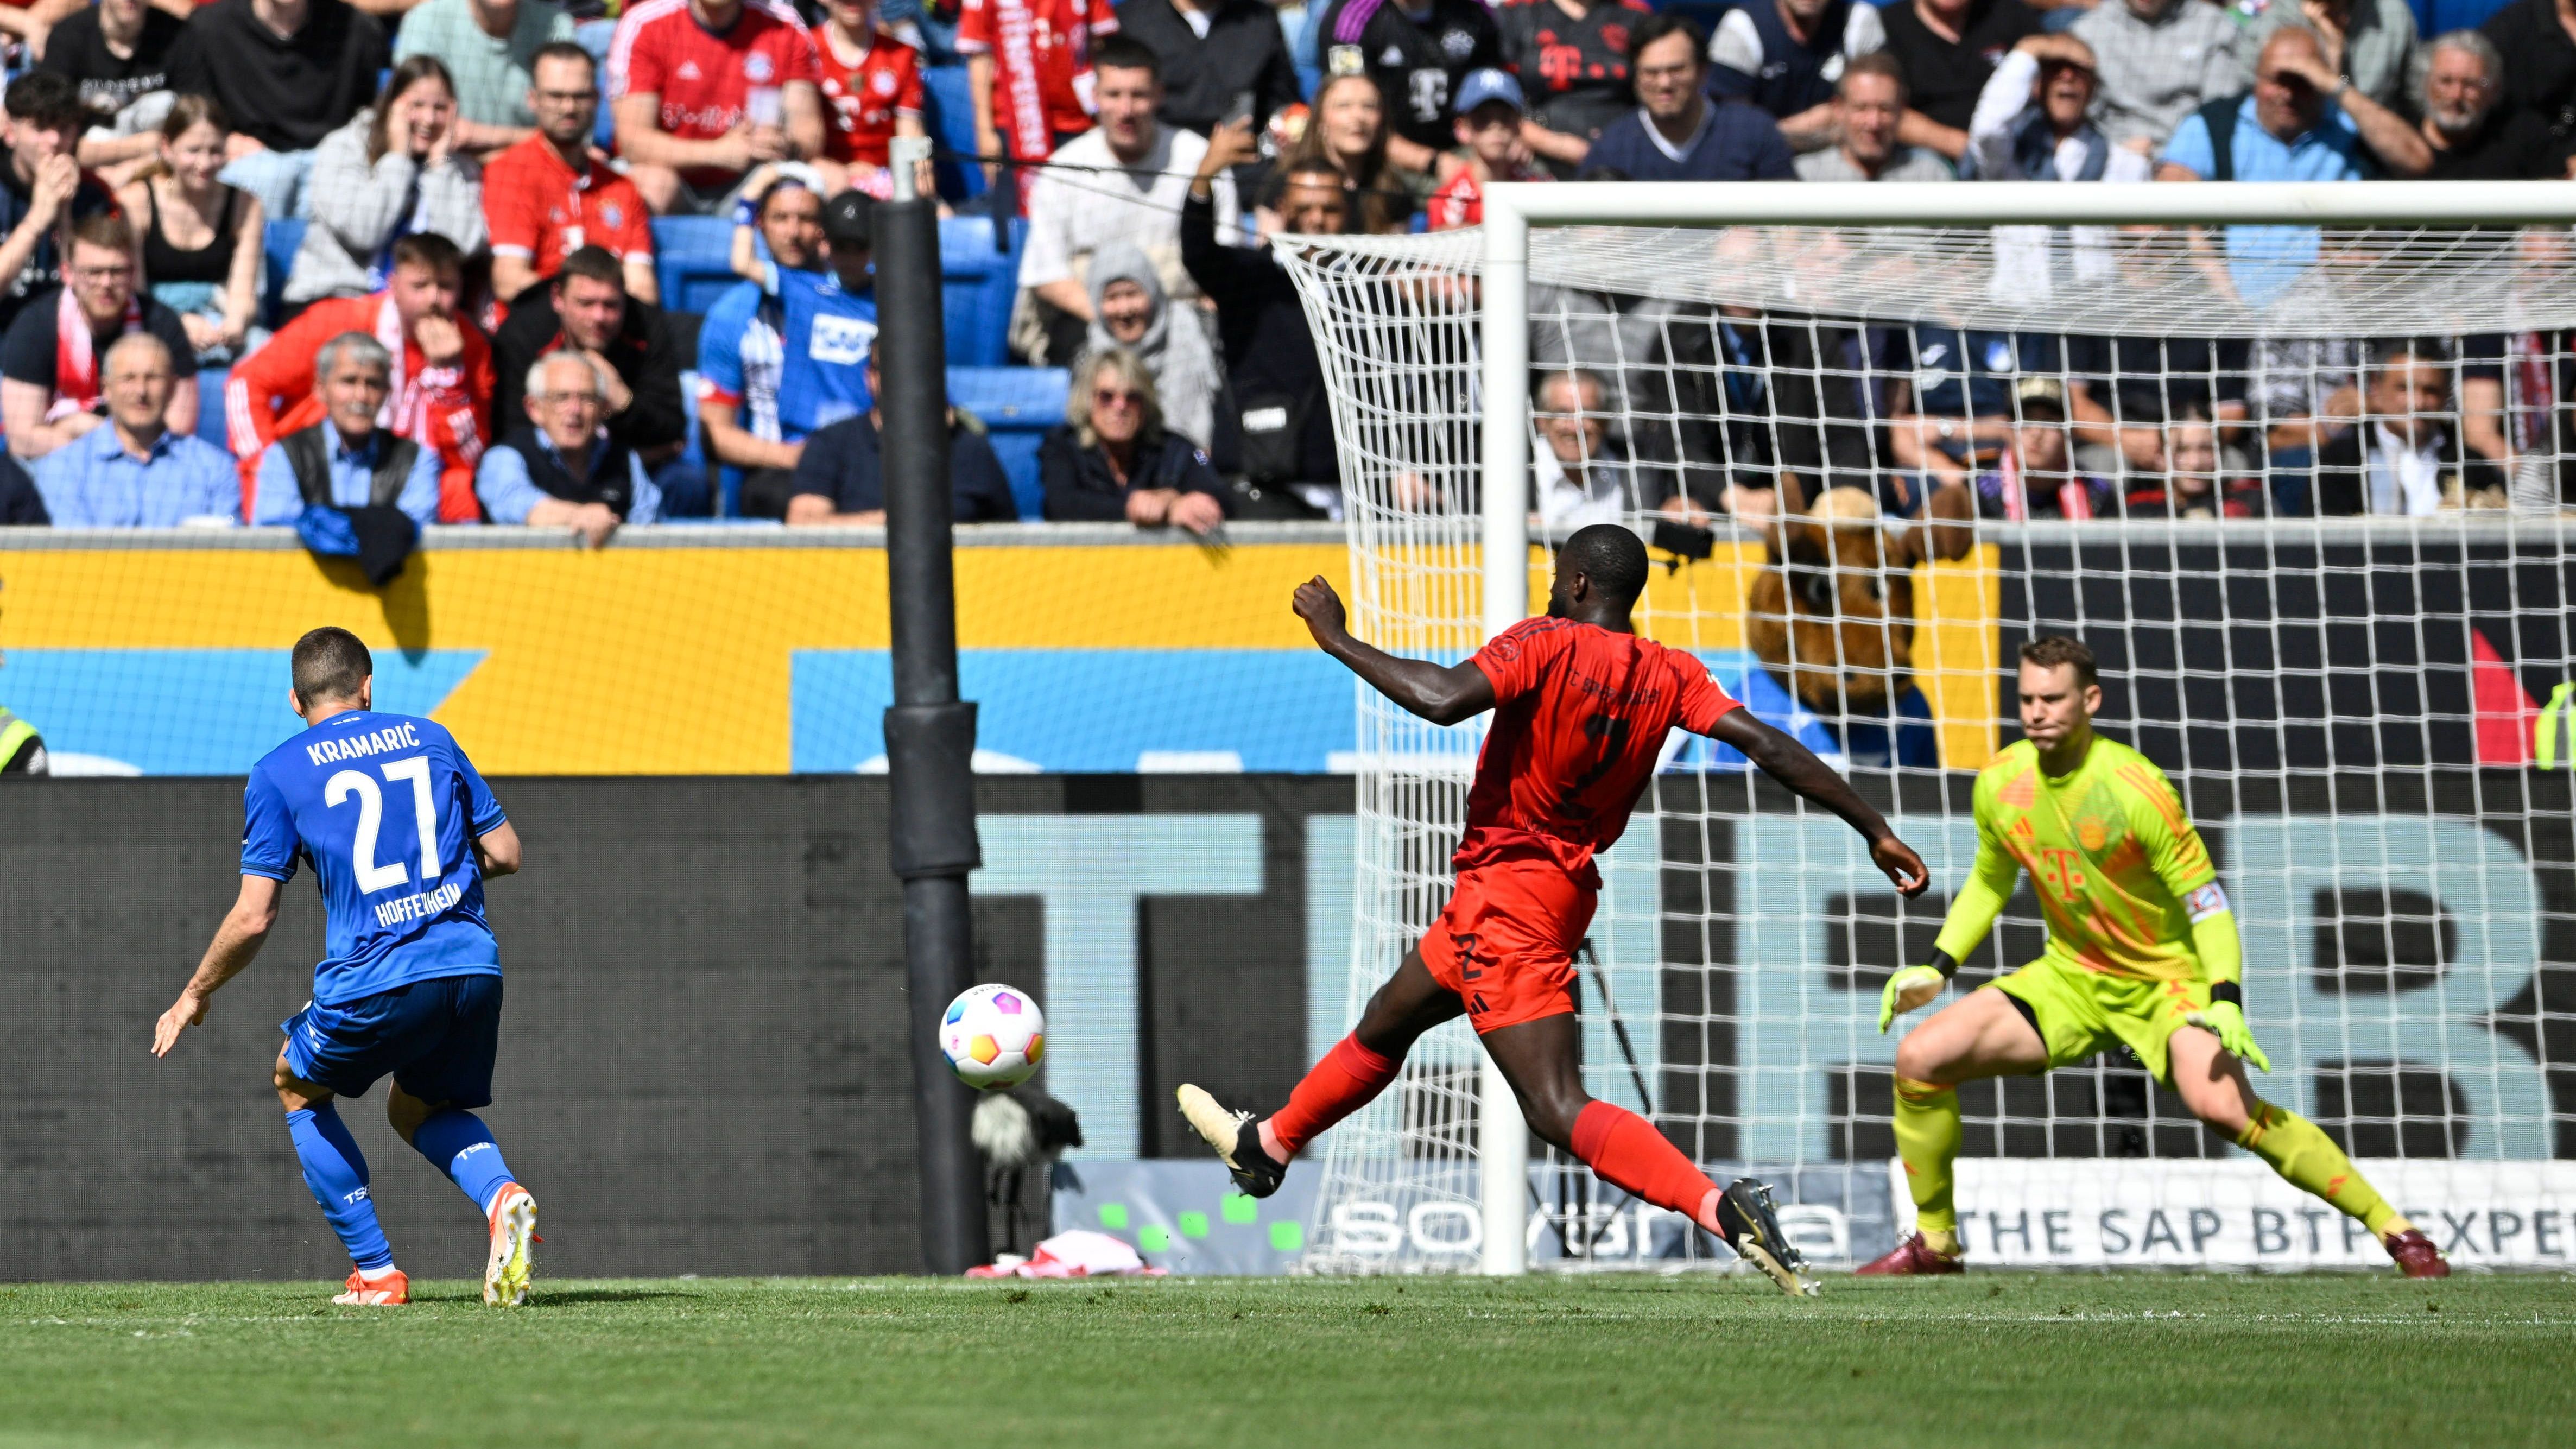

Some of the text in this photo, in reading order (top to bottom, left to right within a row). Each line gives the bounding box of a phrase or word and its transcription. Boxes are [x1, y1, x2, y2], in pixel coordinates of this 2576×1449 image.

[306, 722, 420, 766] KRAMARIĆ
[325, 756, 441, 895] 27
[375, 883, 462, 927] HOFFENHEIM
[457, 1142, 491, 1160] TSG
[1955, 1209, 2073, 1254] THE
[2100, 1209, 2221, 1254] SAP
[2402, 1208, 2576, 1256] XPE
